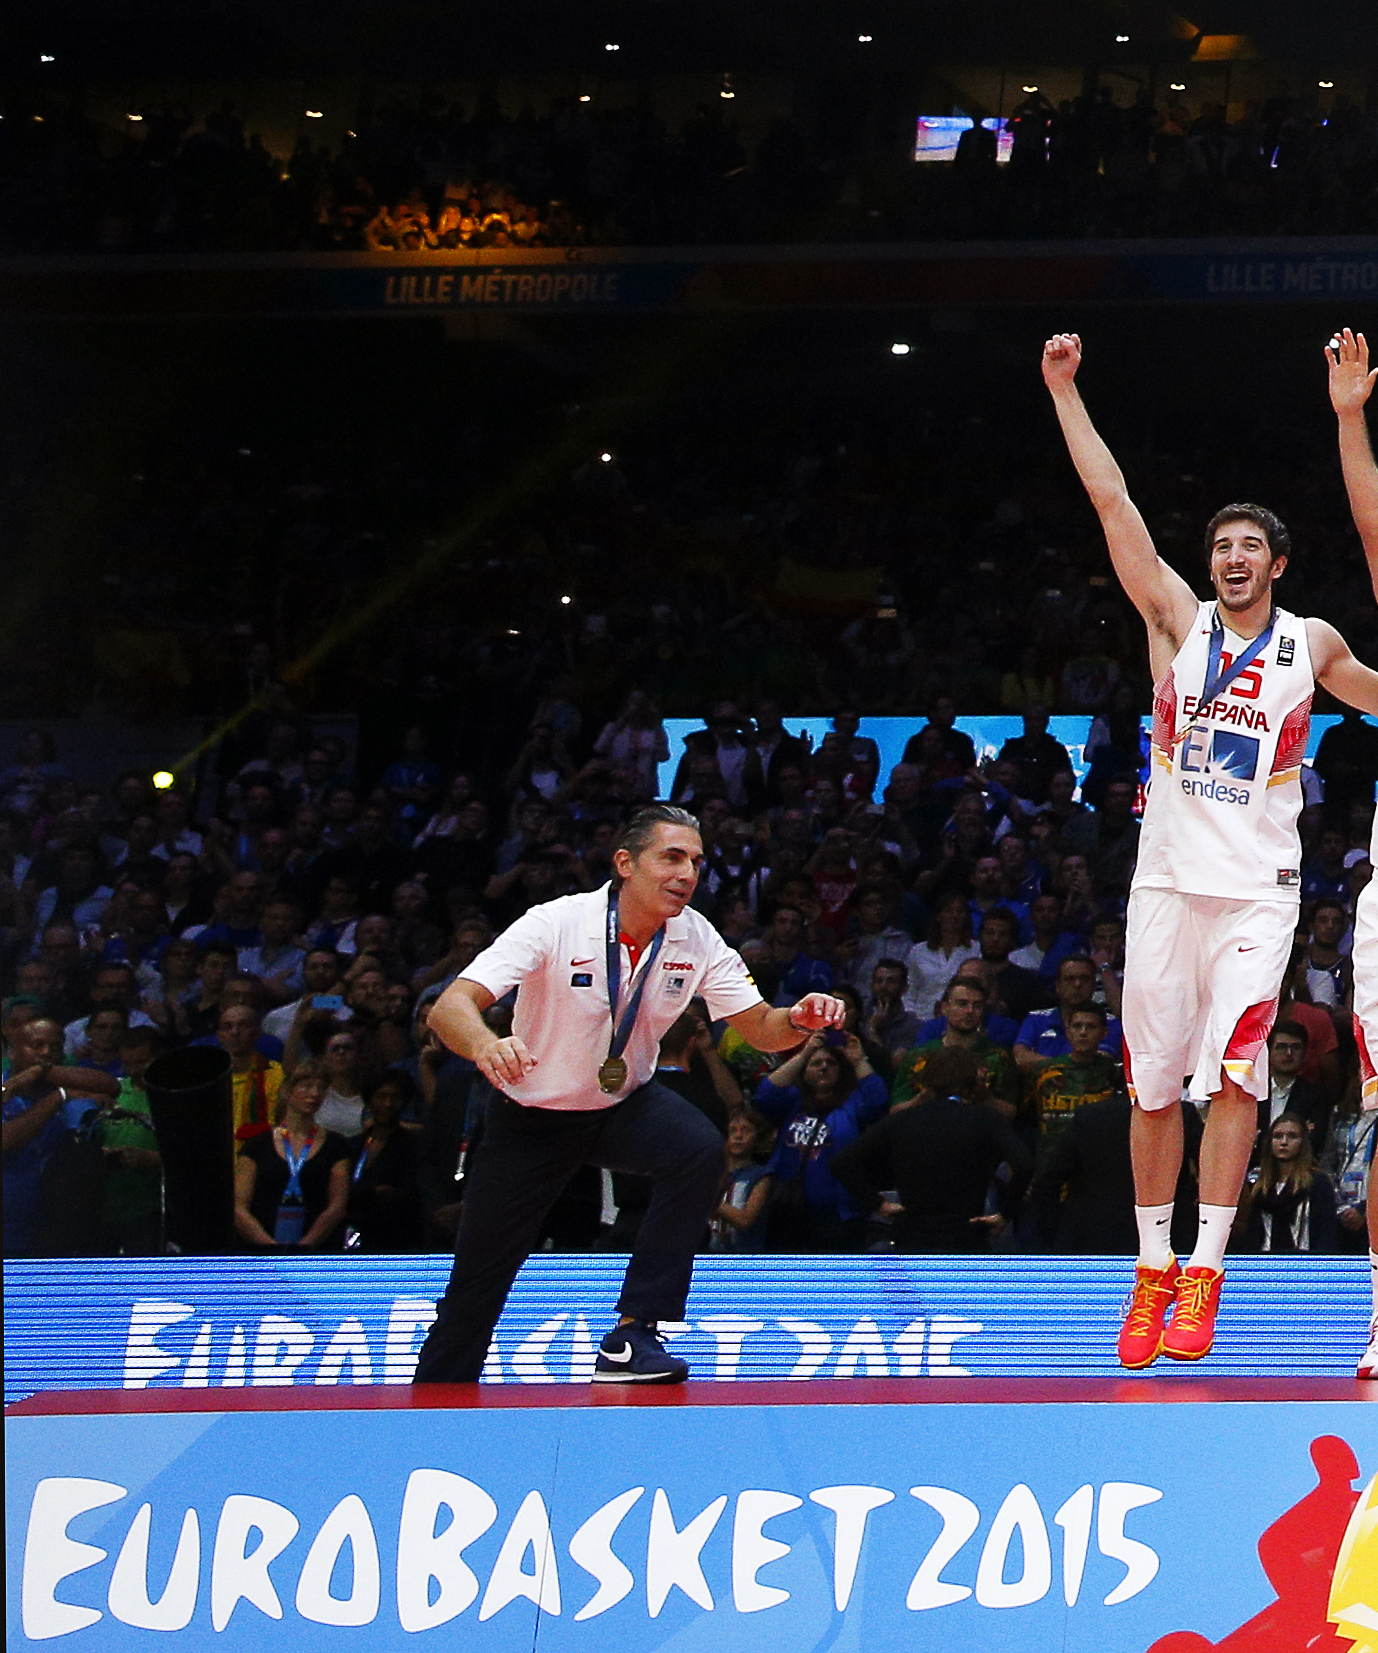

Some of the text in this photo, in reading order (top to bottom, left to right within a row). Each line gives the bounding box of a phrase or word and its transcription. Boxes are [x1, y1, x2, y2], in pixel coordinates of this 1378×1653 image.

[384, 267, 620, 305] LILLE MÉTROPOLE
[1206, 262, 1277, 292] LILLE
[1181, 777, 1251, 806] endesa
[21, 1466, 1164, 1641] EUROBASKET 2015
